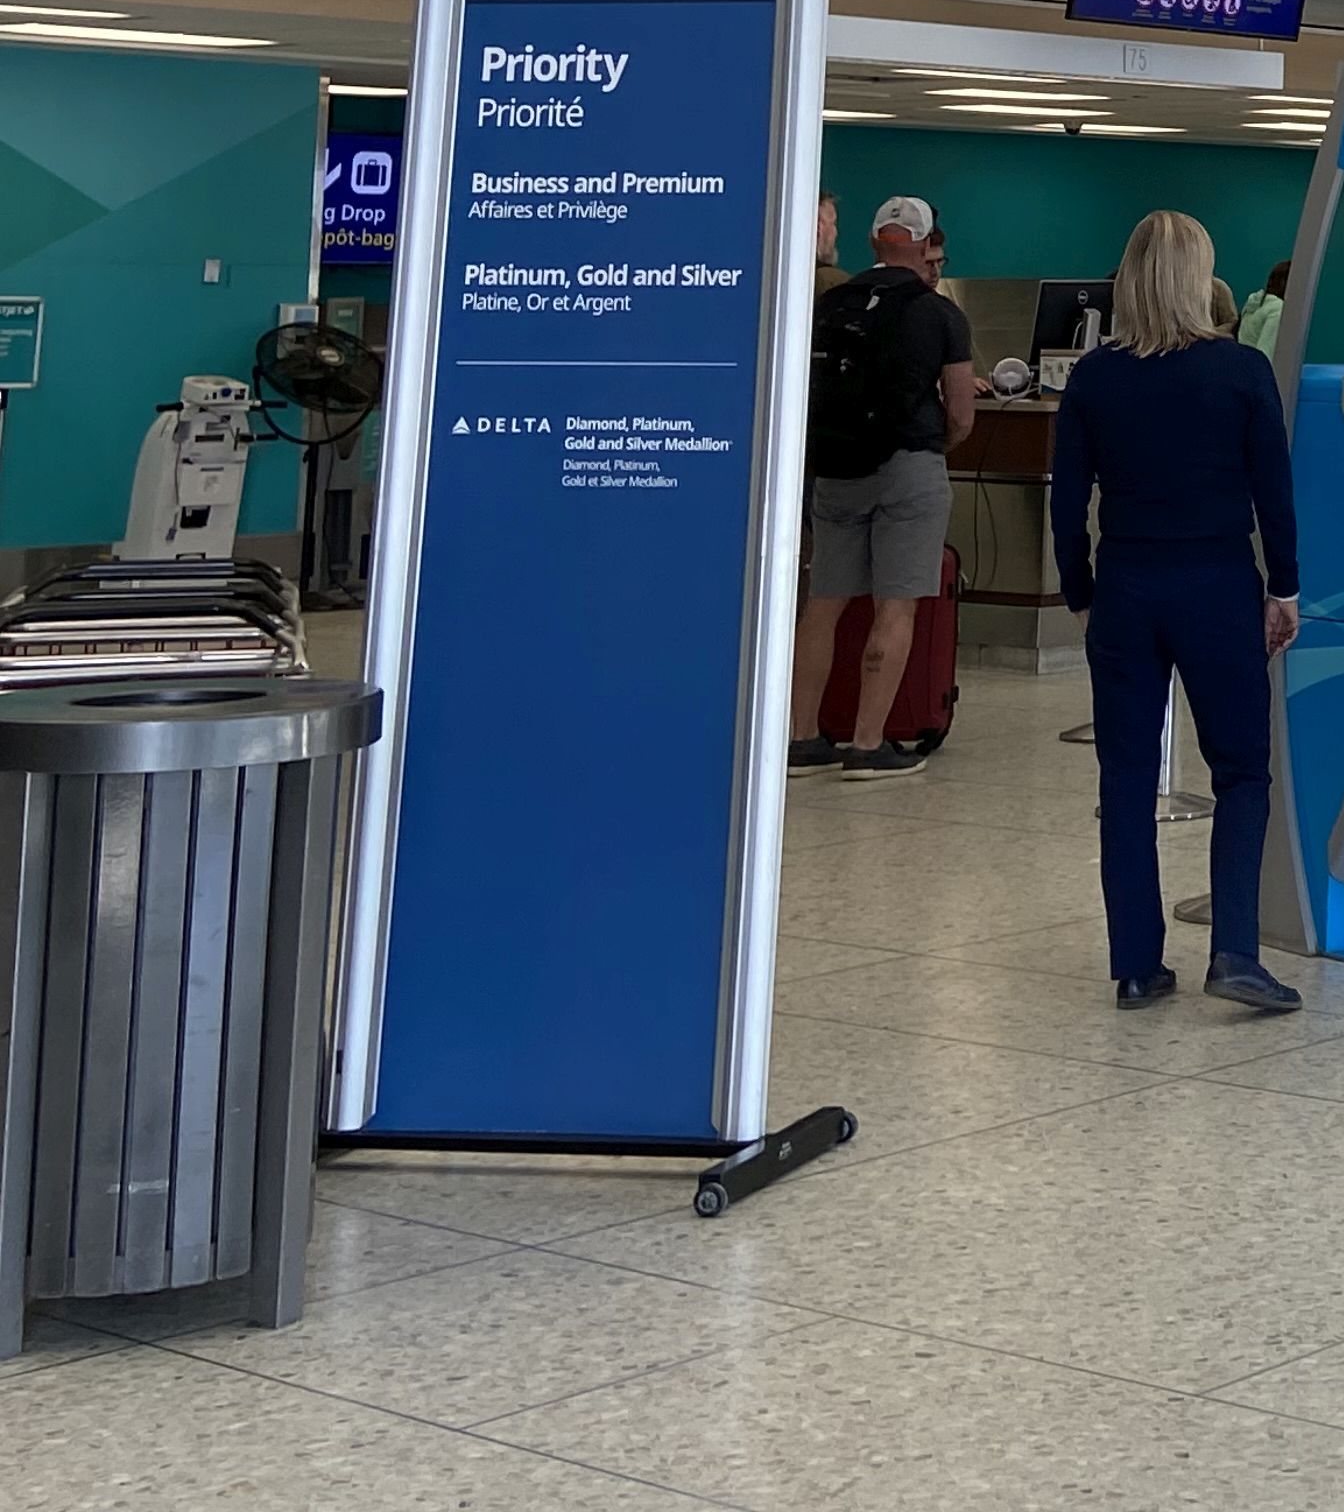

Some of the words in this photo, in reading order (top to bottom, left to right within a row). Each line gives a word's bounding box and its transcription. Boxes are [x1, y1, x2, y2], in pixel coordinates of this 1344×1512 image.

[481, 45, 629, 92] Priority
[1130, 48, 1148, 72] 75
[477, 96, 584, 128] Priorité
[472, 172, 569, 194] Business
[574, 172, 617, 194] and
[622, 173, 724, 195] Premium
[341, 203, 386, 226] Drop
[467, 201, 533, 219] Affaires
[536, 203, 554, 219] et
[558, 200, 628, 223] Privilège
[322, 227, 395, 251] pôt-bag
[464, 264, 572, 290] Platinum,
[577, 265, 628, 286] Gold
[632, 265, 676, 287] and
[681, 264, 742, 287] Silver
[462, 293, 522, 315] Platine,
[526, 294, 549, 312] Or
[552, 296, 570, 312] et
[573, 294, 631, 316] Argent
[477, 417, 552, 433] DELTA
[566, 416, 629, 433] Diamond,
[632, 417, 695, 433] Platinum,
[564, 437, 595, 451] Gold
[597, 437, 624, 451] and
[625, 437, 662, 451] Silver
[562, 459, 612, 471] Diamond,
[614, 459, 660, 472] Platinum,
[561, 475, 586, 487] Gold
[588, 476, 598, 487] et
[600, 475, 627, 487] Silver
[628, 475, 678, 487] Medallion
